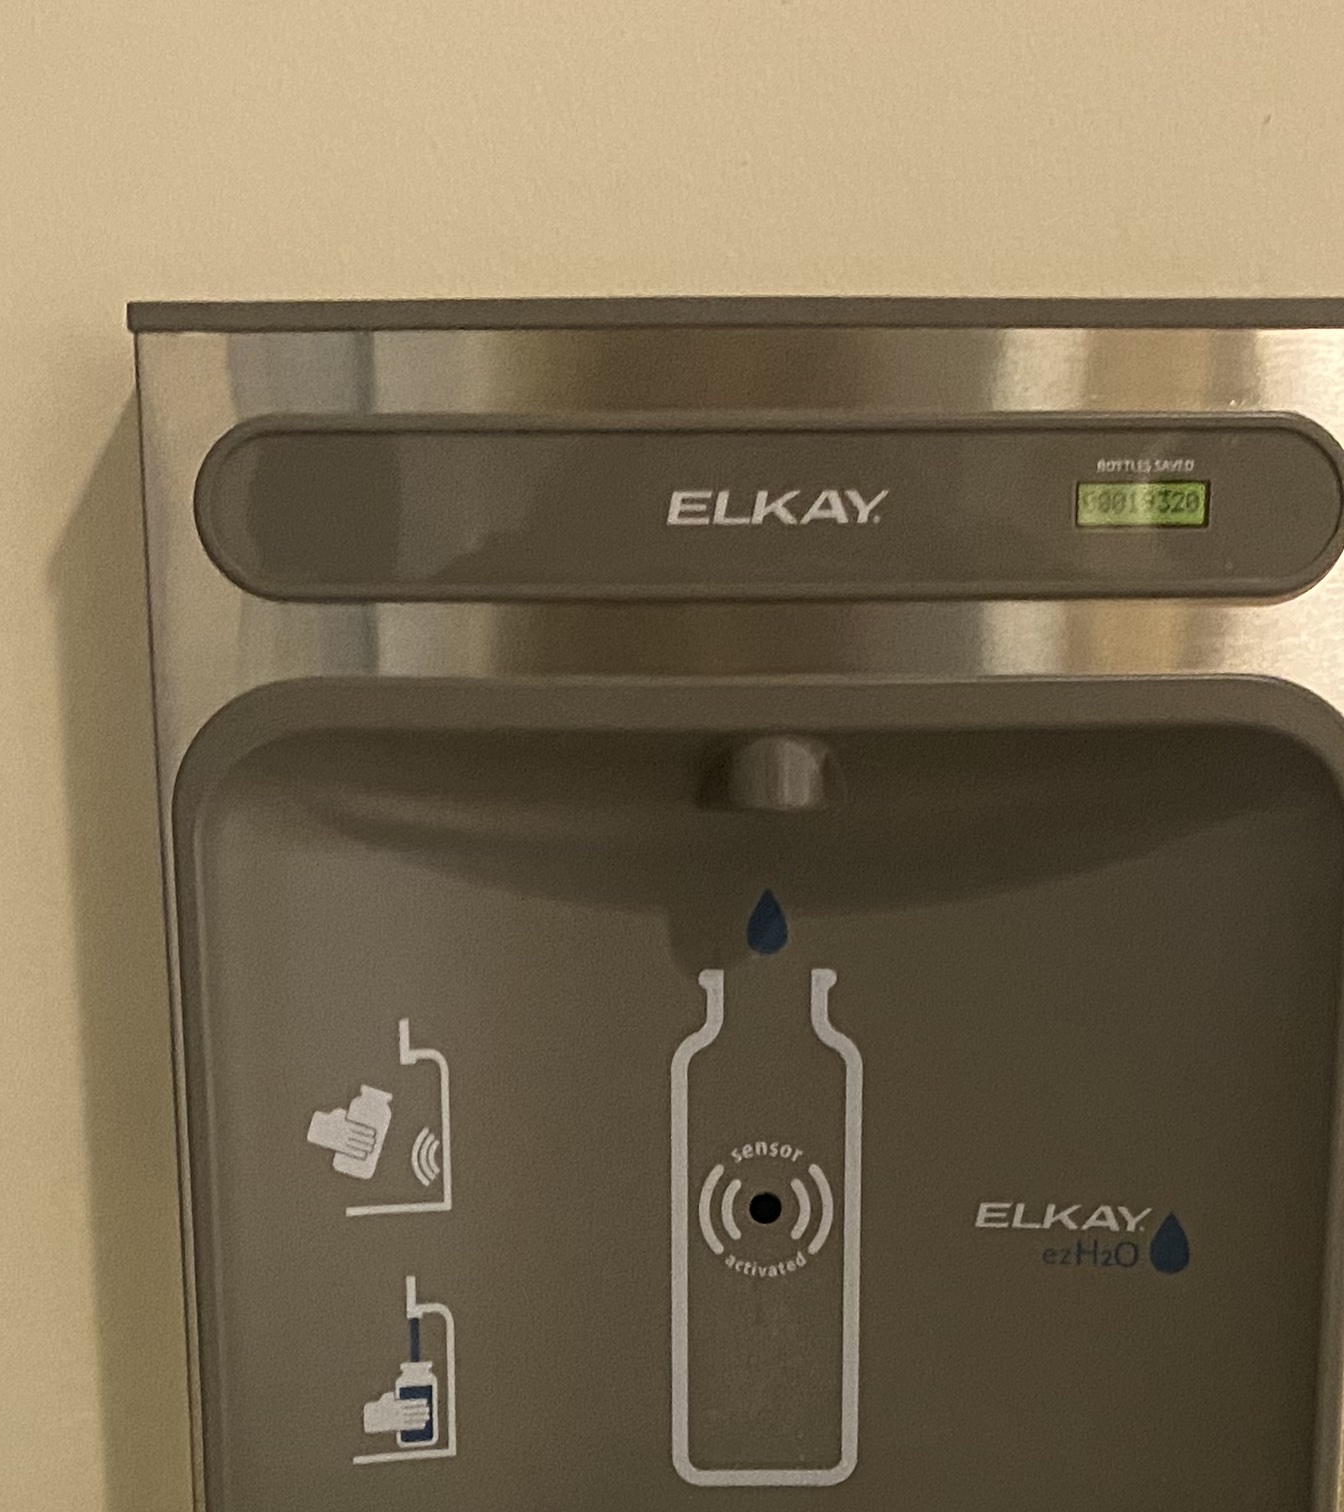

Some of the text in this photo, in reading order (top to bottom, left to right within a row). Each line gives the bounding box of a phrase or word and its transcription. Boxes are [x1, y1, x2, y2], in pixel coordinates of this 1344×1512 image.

[1096, 459, 1196, 474] BOTTLES SAVED
[731, 1141, 805, 1164] sensor
[975, 1201, 1152, 1232] ELKAY
[725, 1251, 807, 1279] activated
